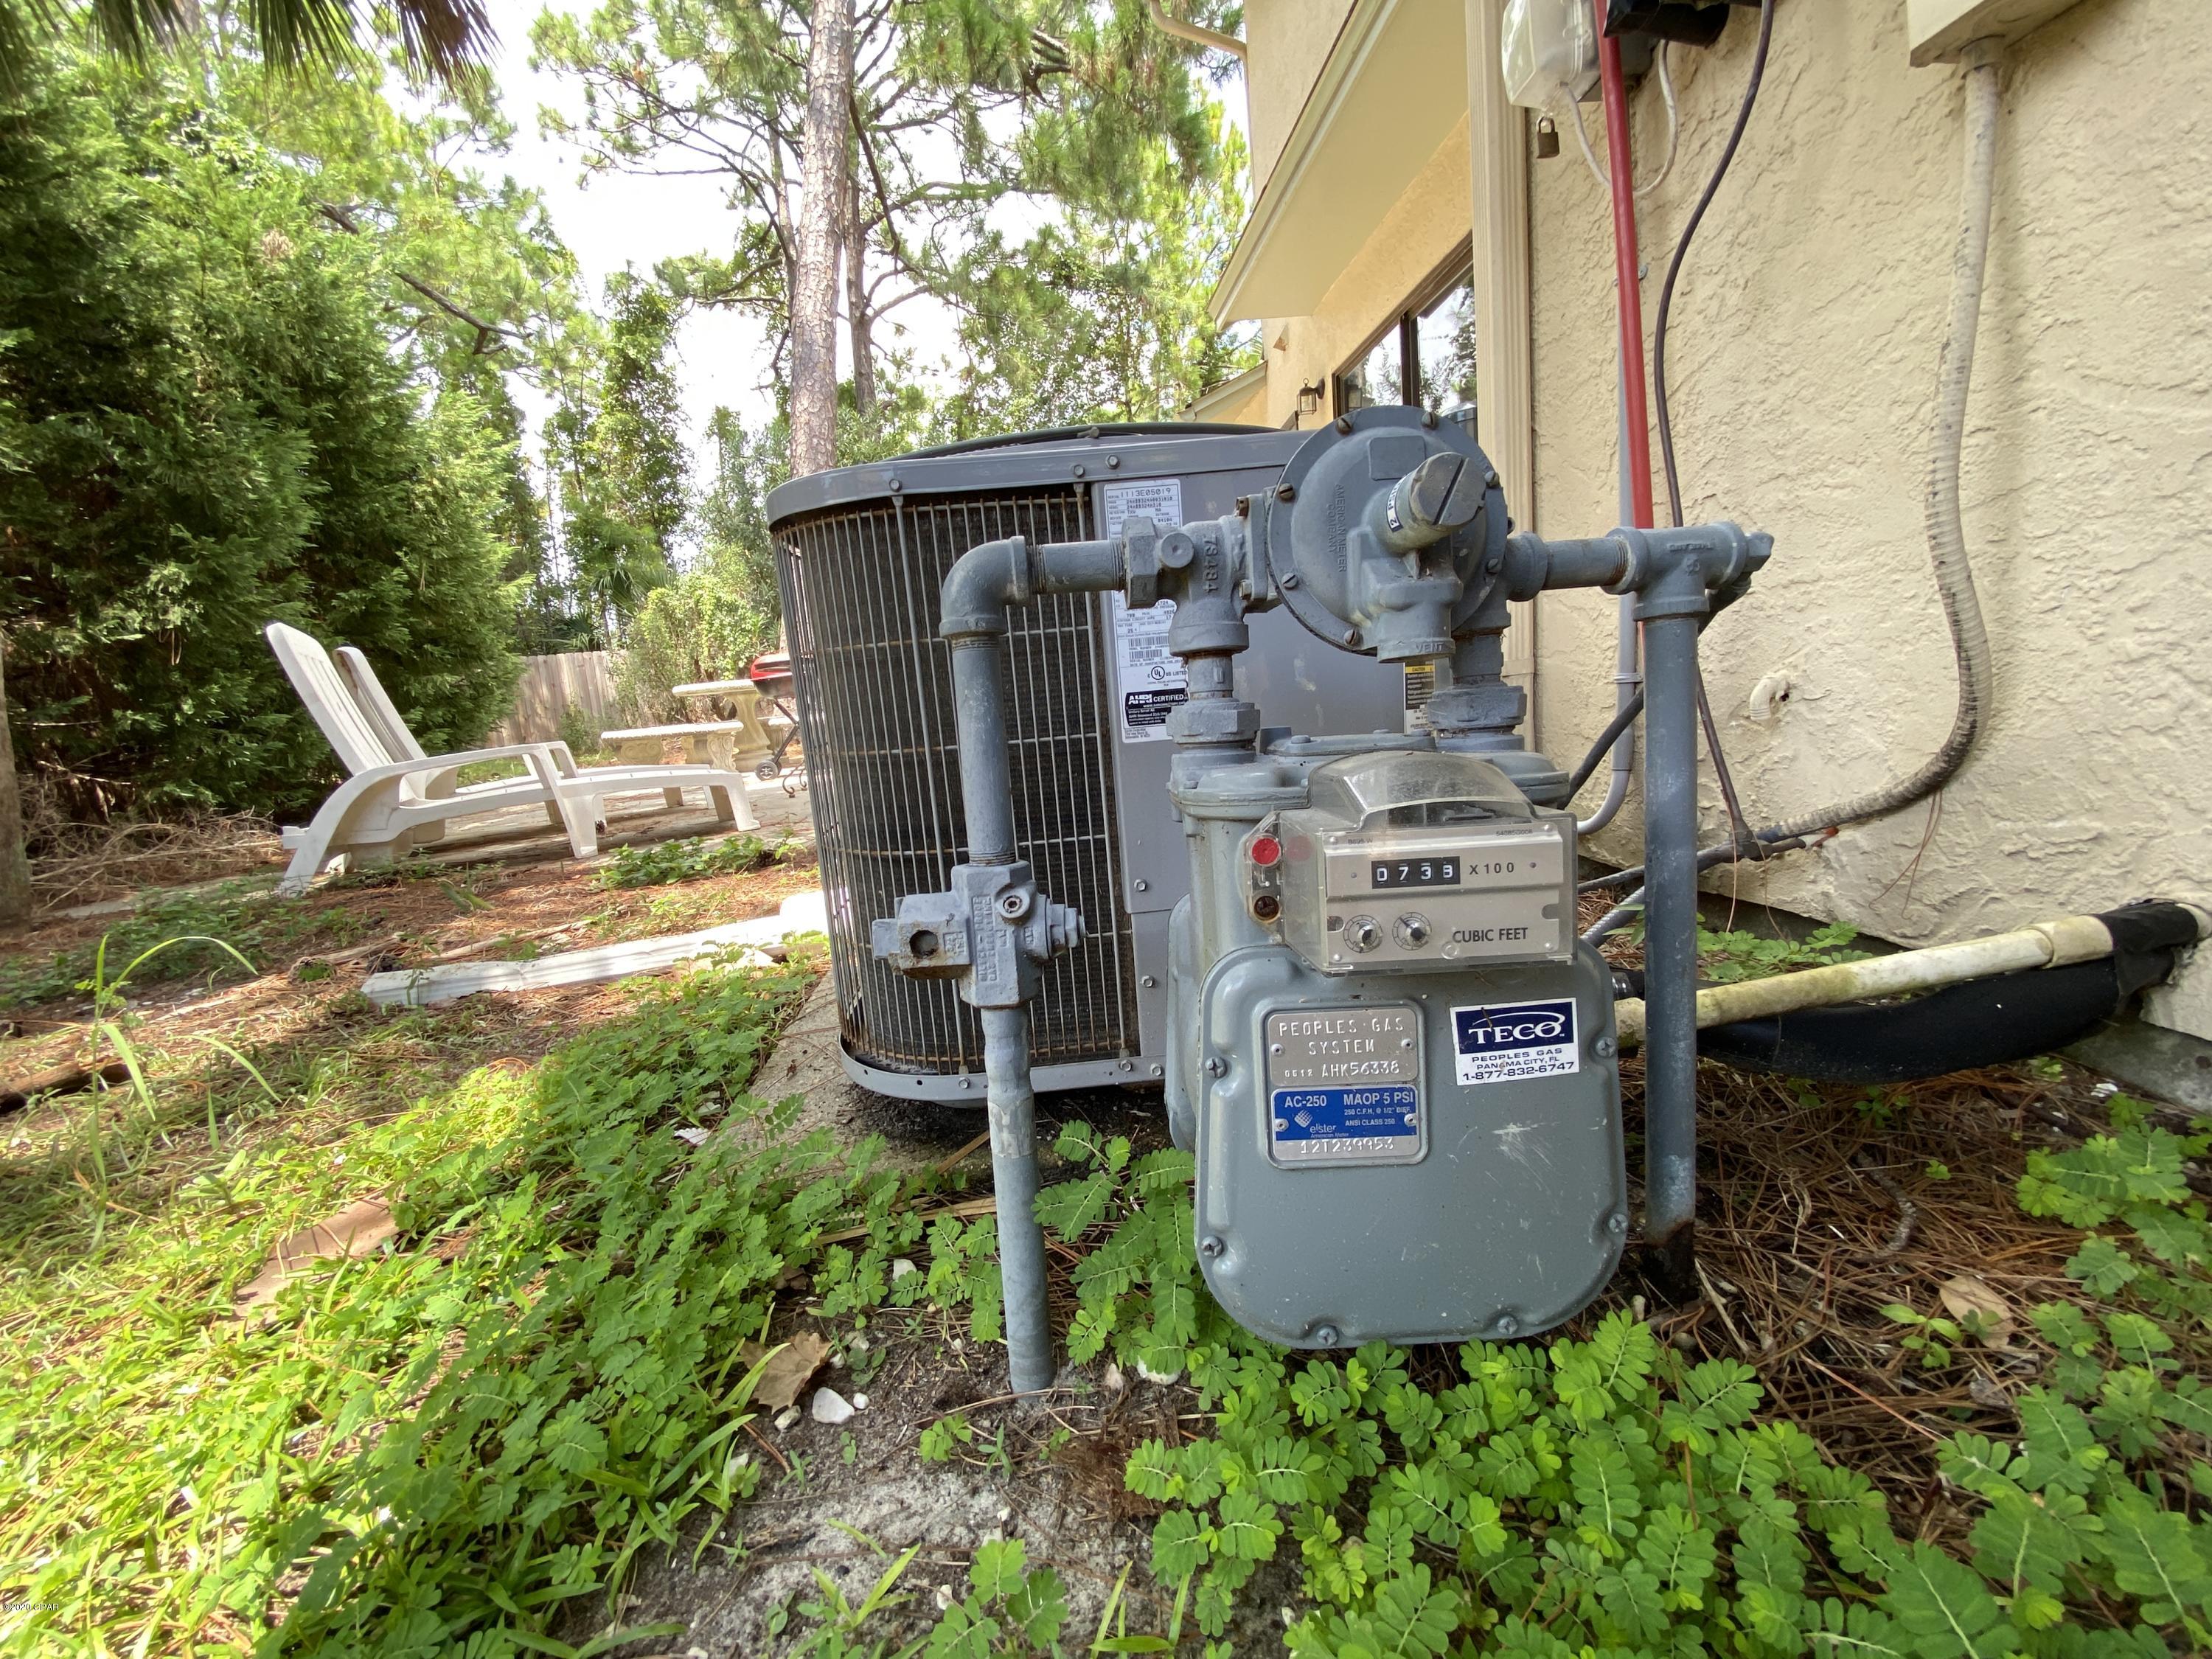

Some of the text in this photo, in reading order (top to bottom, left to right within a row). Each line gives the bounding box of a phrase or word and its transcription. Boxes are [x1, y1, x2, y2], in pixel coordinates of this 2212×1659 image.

[1326, 503, 1338, 553] COMPANY
[1335, 484, 1348, 573] AMERICAN METER
[1416, 641, 1444, 653] VENT
[1153, 694, 1184, 703] CERTIFIED
[1452, 927, 1529, 944] CUBIC FEET
[1279, 1017, 1404, 1037] PEOPLES GAS
[1468, 1020, 1562, 1045] TECO
[1472, 1048, 1563, 1063] PEOPLES GAS
[1523, 1057, 1548, 1066] CITY,
[1463, 1062, 1575, 1082] 1-877-832-6747
[1284, 1091, 1414, 1108] AC-250 MAOP 5 PSI
[1310, 1123, 1337, 1134] elster
